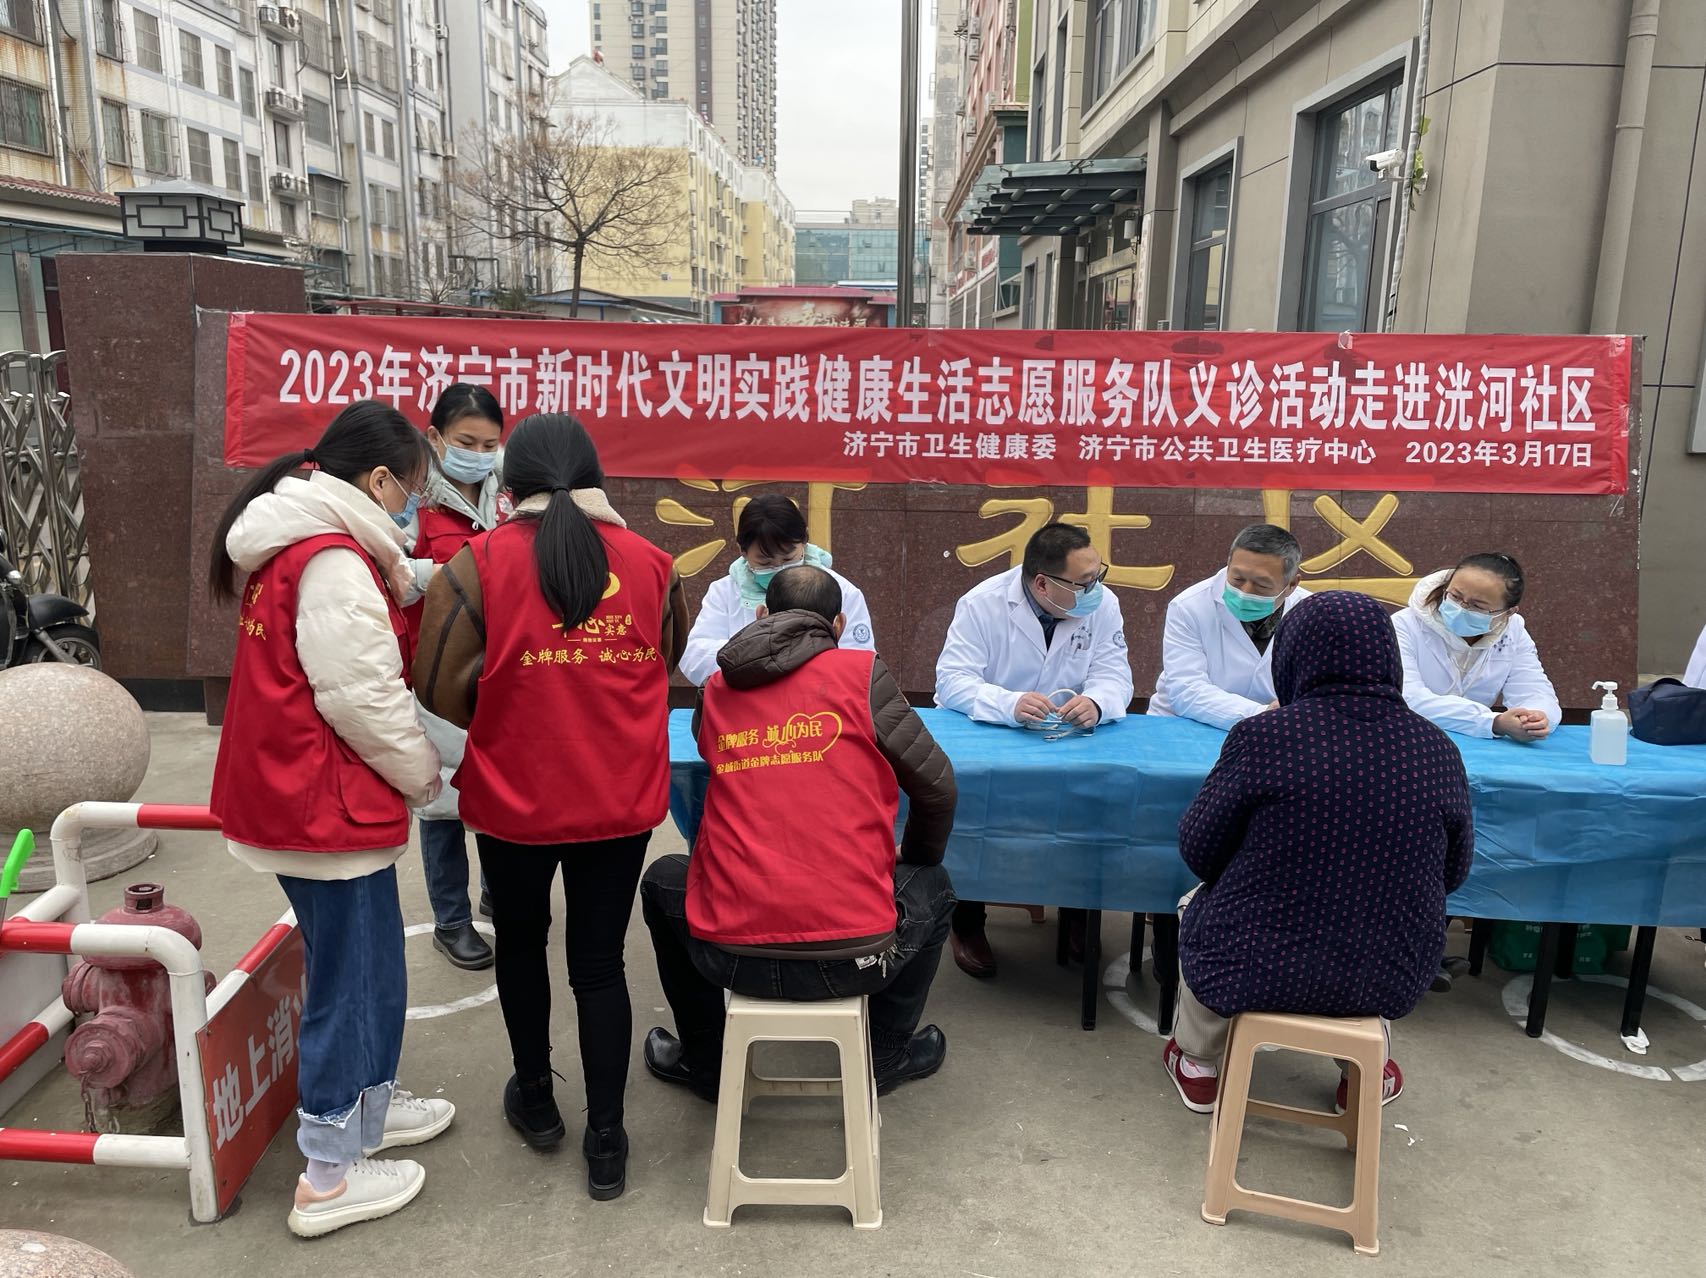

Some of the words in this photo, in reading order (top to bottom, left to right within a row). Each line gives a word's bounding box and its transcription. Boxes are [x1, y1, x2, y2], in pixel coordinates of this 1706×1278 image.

[843, 430, 1057, 460] 济宁市卫生健康委
[1078, 435, 1377, 464] 济宁市公共卫生医疗中心
[1405, 439, 1592, 468] 2023年3月17日
[519, 648, 589, 667] 金牌服务
[598, 646, 657, 664] 诚心为民
[717, 728, 760, 753] 金牌服务
